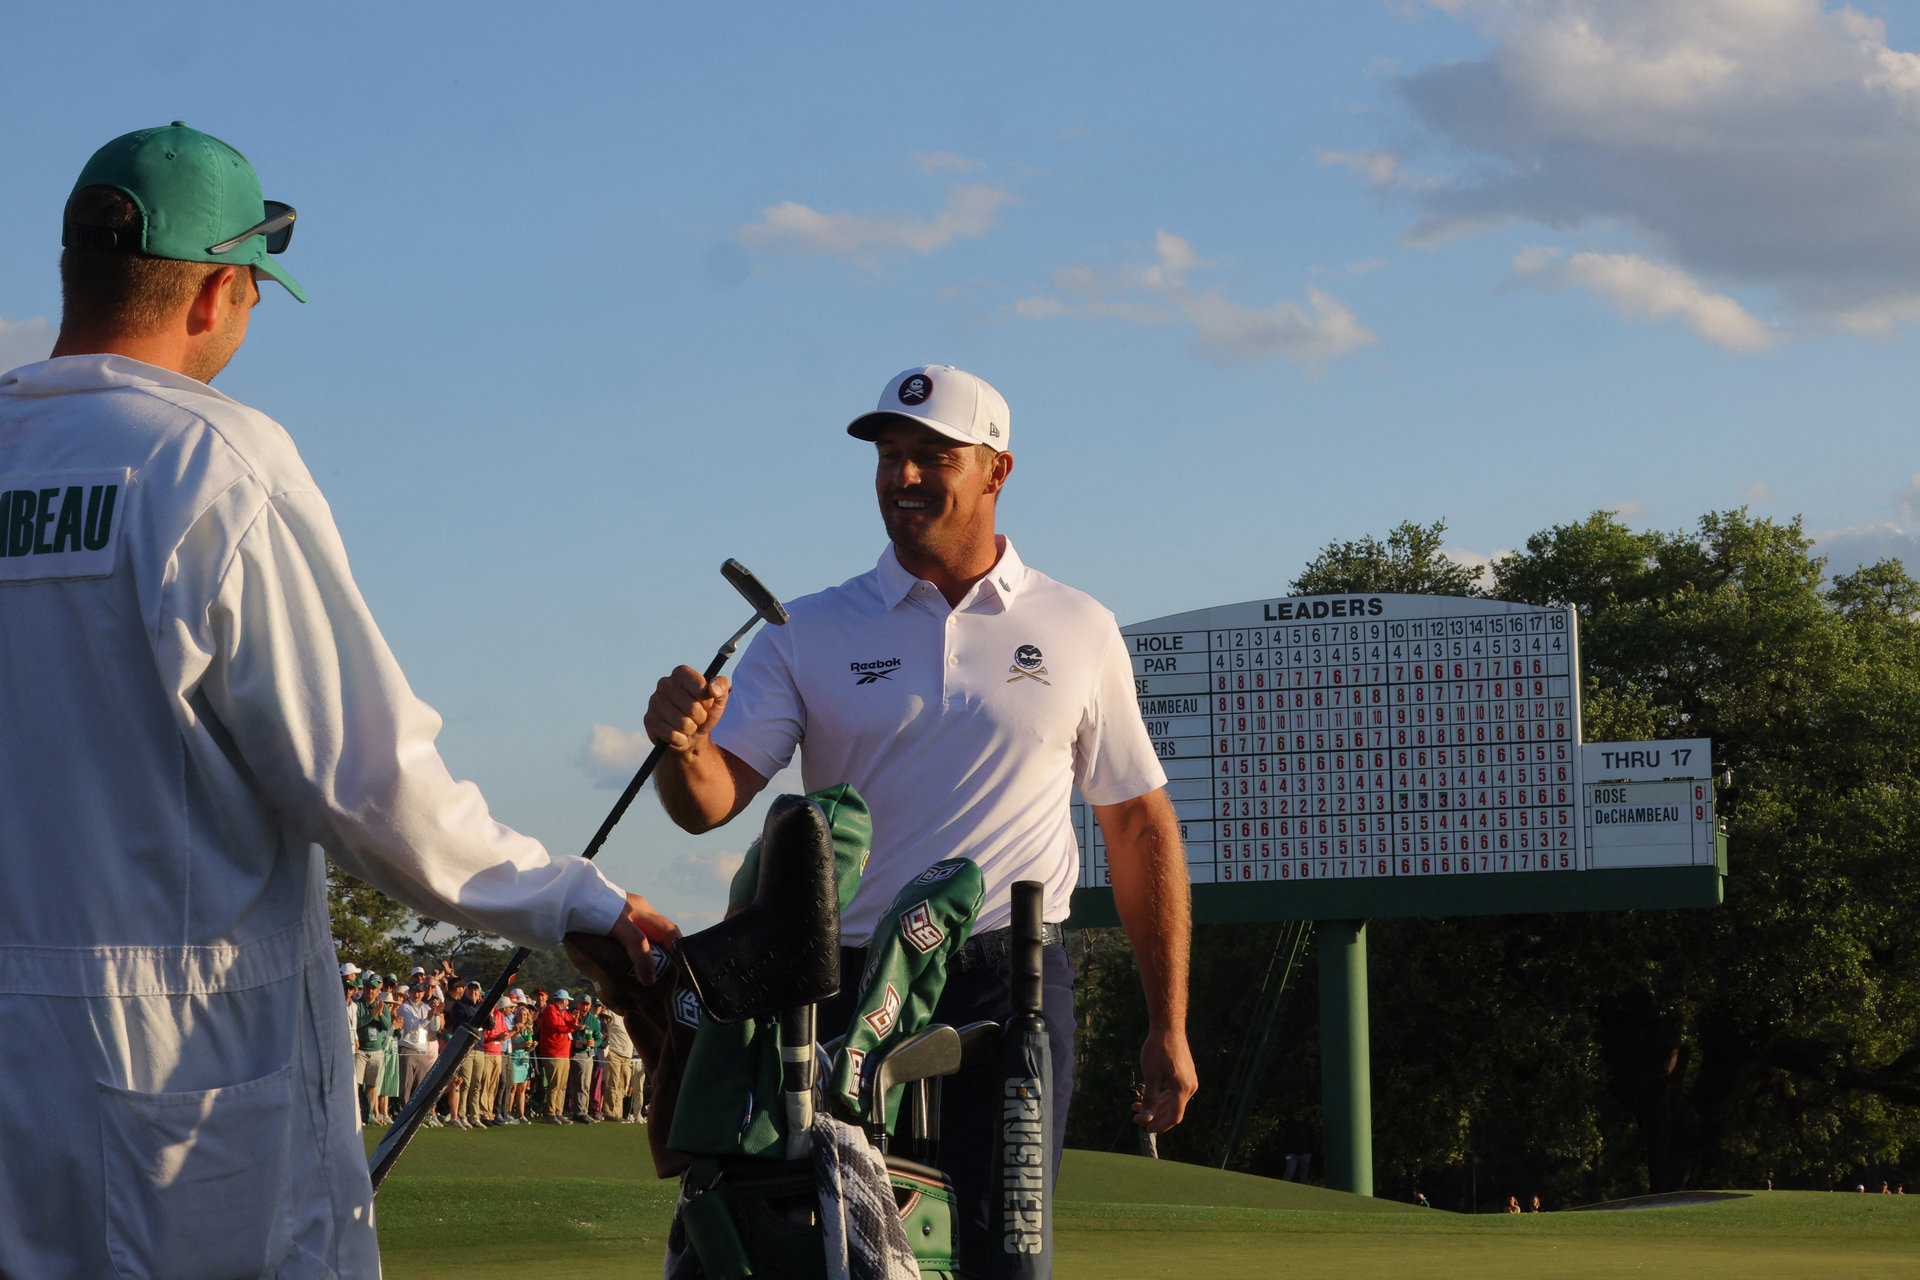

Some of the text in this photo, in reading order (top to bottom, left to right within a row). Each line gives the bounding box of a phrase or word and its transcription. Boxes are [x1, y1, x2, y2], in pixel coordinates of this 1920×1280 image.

[1264, 598, 1383, 621] LEADERS
[1137, 615, 1564, 652] HOLE 1 2 3 4 5 6 7 8 9 10 11 12 13 14 15 16 17 18
[851, 658, 901, 672] Reebok
[1144, 637, 1562, 672] PAR 4 5 4 3 4 3 4 5 4 4 4 3 5 4 5 3 4 4
[1135, 659, 1542, 694] SE 8 8 8 7 7 7 6 7 7 7 6 6 6 7 7 6 6
[1140, 681, 1544, 715] HAMBEAU 8 9 8 8 8 8 7 8 8 8 8 7 7 7 8 9 9
[1147, 701, 1564, 736] ROY 7 9 10 10 11 11 11 10 10 9 9 9 10 10 12 12 12 12
[1154, 723, 1564, 756] ERS 6 7 7 6 6 5 5 6 7 8 8 8 8 8 8 8 8 8
[1601, 749, 1692, 769] THRU 17
[1595, 785, 1703, 804] ROSE 6
[1224, 817, 1386, 838] 5 6 6 6 6 6 5 5 5
[1595, 805, 1704, 824] DeCHAMBEAU 9
[1224, 854, 1568, 880] 5 6 7 6 6 7 7 7 6 6 6 6 6 7 7 7 6 5
[1003, 1077, 1042, 1255] CRUSHERS
